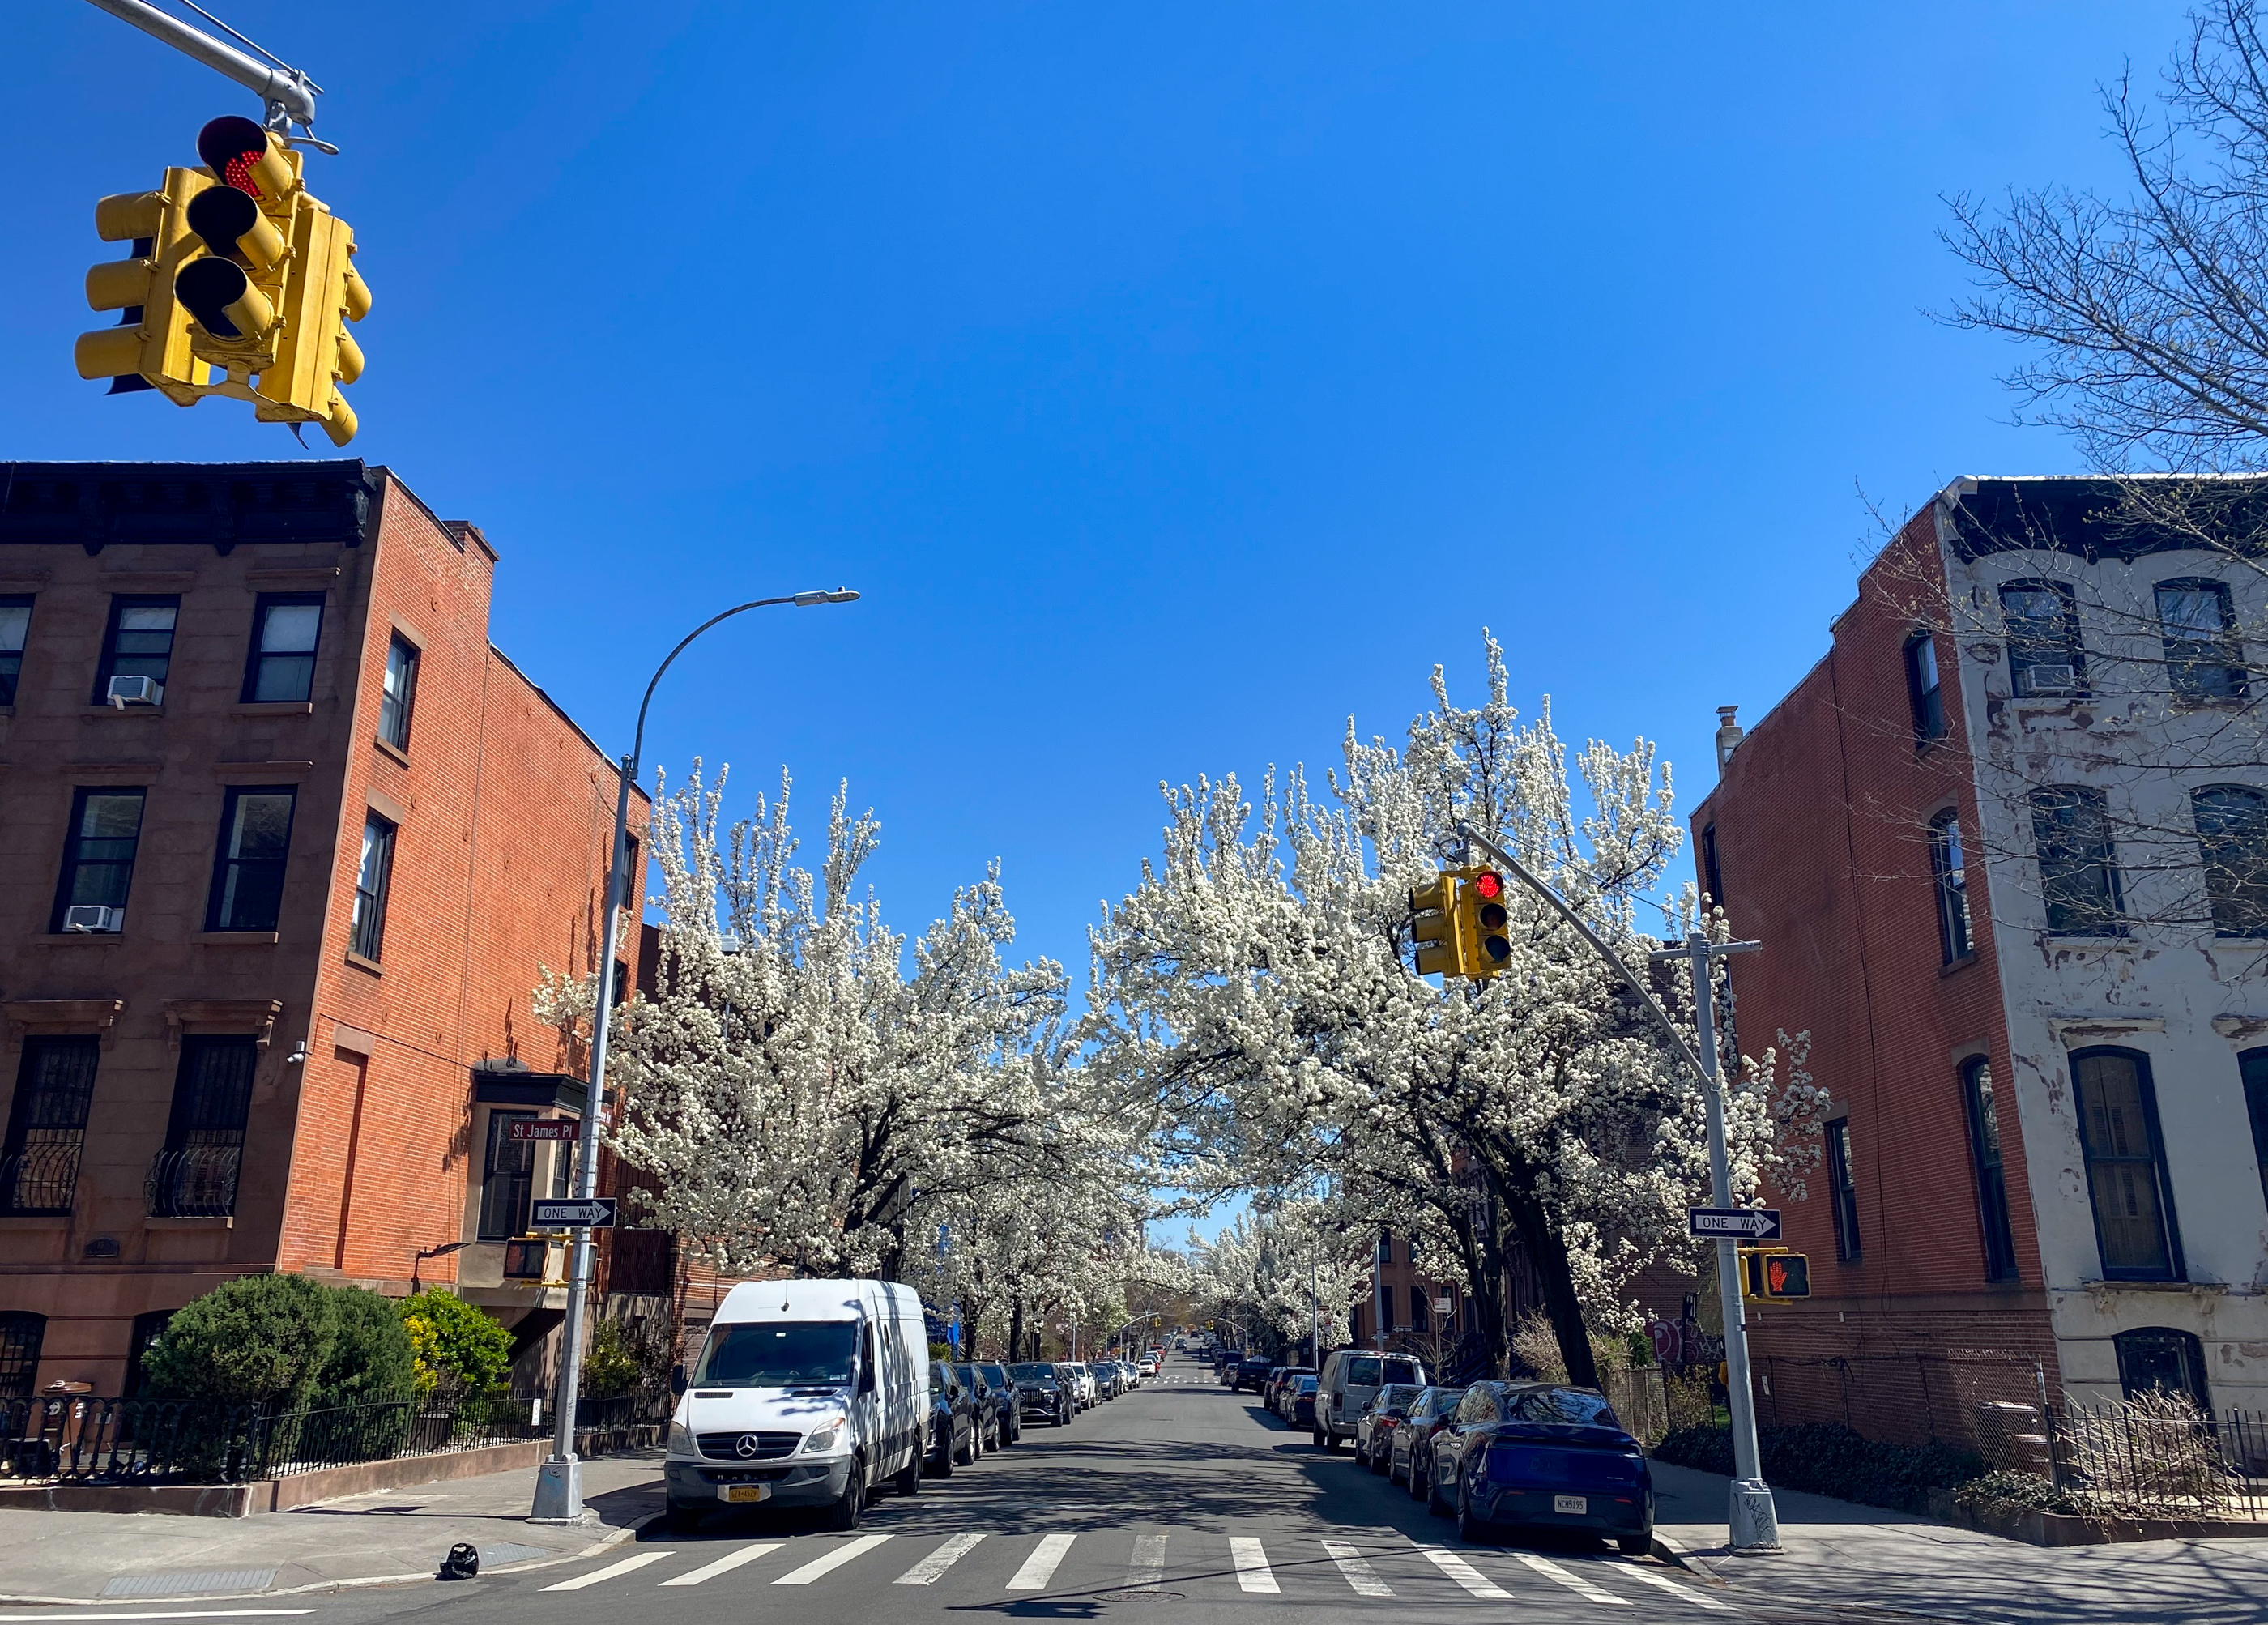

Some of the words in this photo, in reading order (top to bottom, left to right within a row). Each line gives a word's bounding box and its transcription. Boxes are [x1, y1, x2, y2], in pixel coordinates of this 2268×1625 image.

[513, 1124, 524, 1137] St
[526, 1124, 559, 1138] James
[562, 1124, 573, 1138] Pl
[544, 1208, 567, 1218] ONE
[578, 1208, 603, 1218] WAY
[1703, 1217, 1729, 1229] ONE
[1740, 1218, 1767, 1230] WAY
